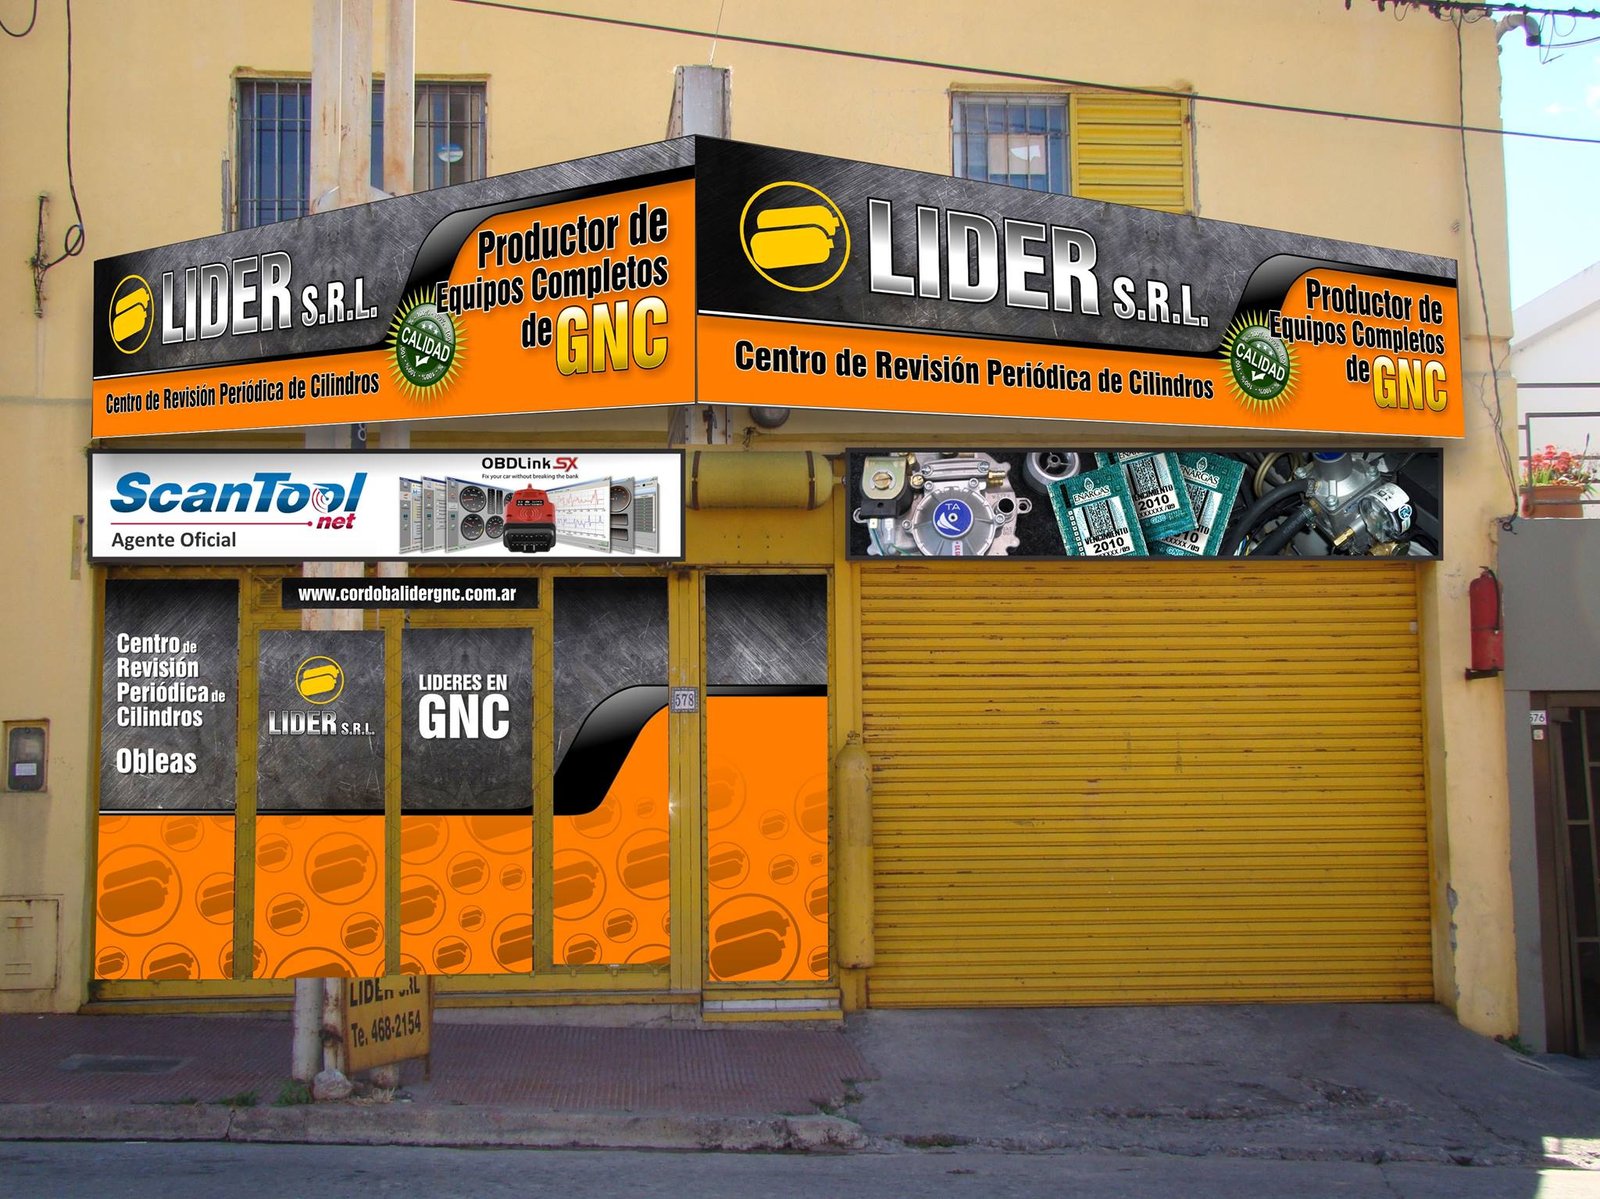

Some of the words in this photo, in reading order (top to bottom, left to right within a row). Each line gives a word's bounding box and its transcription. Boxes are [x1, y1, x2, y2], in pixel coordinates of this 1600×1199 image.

[477, 214, 619, 269] Productor
[629, 202, 668, 247] de
[868, 197, 1100, 316] LIDER
[1112, 275, 1209, 328] S.R.L.
[161, 250, 292, 344] LIDER
[301, 277, 378, 327] S.R.L.
[436, 276, 525, 316] Equipos
[531, 255, 669, 301] Completos
[1305, 277, 1413, 321] Productor
[1418, 294, 1443, 325] de
[401, 327, 451, 362] CALIDAD
[521, 312, 553, 348] de
[556, 295, 669, 377] GNC
[1268, 309, 1346, 346] Equipos
[1352, 320, 1445, 355] Completos
[734, 340, 827, 375] Centro
[835, 348, 867, 378] de
[875, 350, 980, 385] Revisión
[986, 358, 1092, 392] Periódica
[1098, 367, 1123, 394] de
[1129, 369, 1215, 400] Cilindros
[1235, 343, 1286, 382] CALIDAD
[105, 392, 142, 415] Centro
[145, 390, 161, 411] de
[163, 384, 216, 410] Revisión
[219, 378, 284, 405] Periódica
[288, 376, 306, 400] de
[310, 371, 380, 396] Cilindros
[1346, 353, 1370, 383] de
[1372, 354, 1447, 412] GNC
[481, 457, 551, 469] OBDLink
[552, 457, 578, 472] SX
[110, 472, 368, 514] ScanTool
[1074, 486, 1110, 501] ENARGAS
[1133, 485, 1173, 501] ENCIMIENTO
[1138, 494, 1169, 510] 2010
[945, 503, 961, 511] TA
[111, 531, 175, 550] Agente
[180, 531, 236, 548] Oficial
[1093, 537, 1124, 553] 2010
[298, 585, 517, 603] www.cordobalidergnc.com.ar
[117, 633, 180, 653] Centro
[183, 641, 197, 653] de
[117, 657, 199, 678] Revisión
[117, 682, 209, 702] Periódica
[211, 690, 226, 702] de
[419, 674, 482, 691] LIDERES
[487, 674, 508, 691] EN
[675, 693, 694, 707] 578
[117, 706, 204, 727] Cilindros
[268, 710, 338, 736] LIDER
[341, 722, 375, 736] S.R.L.
[418, 693, 510, 739] GNC
[116, 748, 197, 774] Obleas
[351, 1022, 368, 1048] Te.
[372, 1009, 421, 1043] 468-2154
